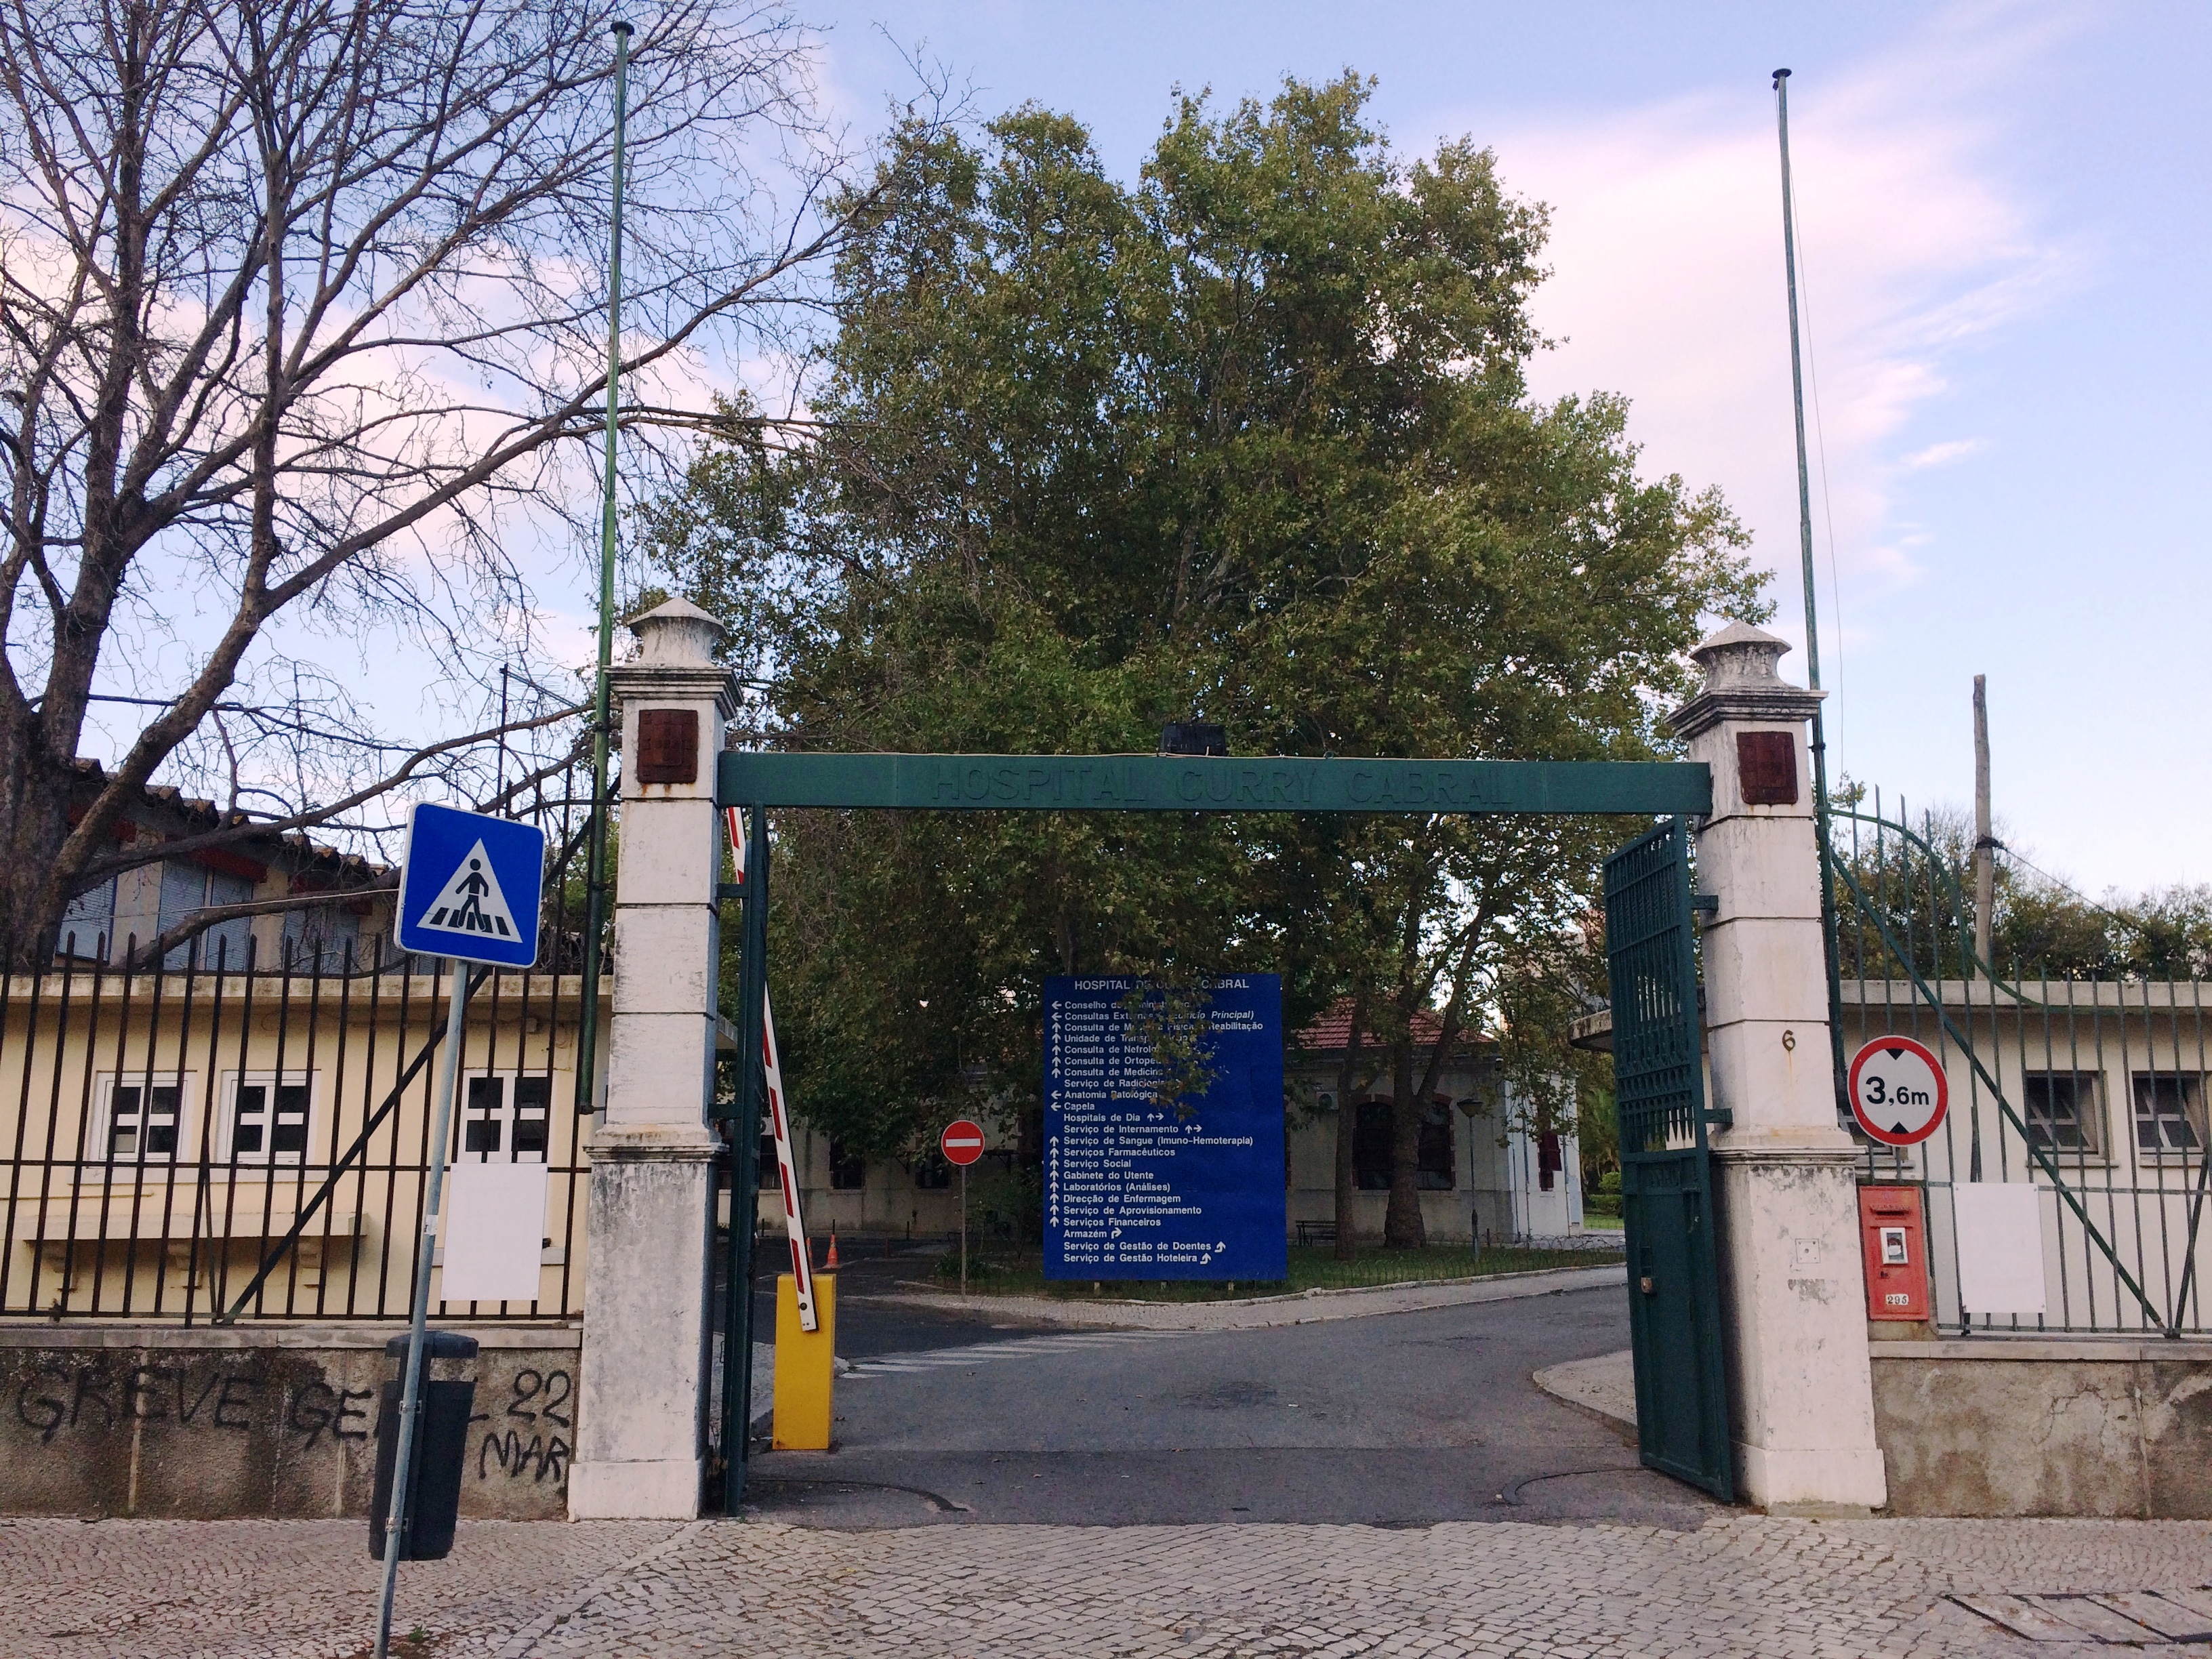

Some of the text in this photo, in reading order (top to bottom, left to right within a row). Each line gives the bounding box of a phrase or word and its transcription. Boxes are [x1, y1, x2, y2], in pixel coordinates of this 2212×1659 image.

[933, 764, 1513, 804] HOSPITAL CURRY CABRAL
[1074, 980, 1130, 990] HOSPITAL
[1064, 1001, 1107, 1009] Conselho
[1211, 1010, 1254, 1021] Principal)
[1064, 1023, 1104, 1031] Consulta
[1064, 1034, 1100, 1042] Unidade
[1105, 1034, 1115, 1042] de
[1782, 1029, 1797, 1052] 6
[1064, 1046, 1104, 1054] Consulta
[1064, 1057, 1104, 1065] Consulta
[1064, 1068, 1104, 1076] Consulta
[1109, 1068, 1120, 1076] de
[1064, 1080, 1099, 1089] Serviço
[1865, 1076, 1930, 1107] 3,6m
[1064, 1102, 1095, 1112] Capela
[1063, 1113, 1141, 1124] Hospitais de Dia
[1063, 1125, 1179, 1134] Serviço de Internamento
[1063, 1136, 1099, 1147] Serviço
[1103, 1136, 1114, 1145] de
[1119, 1136, 1153, 1147] Sangue
[1063, 1148, 1104, 1158] Serviços
[1063, 1160, 1132, 1170] Serviço Social
[1063, 1171, 1154, 1180] Gabinete do Utente
[1063, 1183, 1170, 1193] Laboratórios (Análises)
[1063, 1194, 1181, 1204] Direcção de Enfermagem
[1063, 1206, 1202, 1216] Serviço de Aprovisionamento
[1063, 1218, 1162, 1228] Serviços Financeiros
[1063, 1229, 1107, 1238] Armazém
[1063, 1242, 1212, 1252] Serviço de Gestão de Doentes
[1063, 1254, 1197, 1264] Serviço de Gestão Hoteleira
[18, 1361, 268, 1446] GREVE
[507, 1370, 571, 1427] 22
